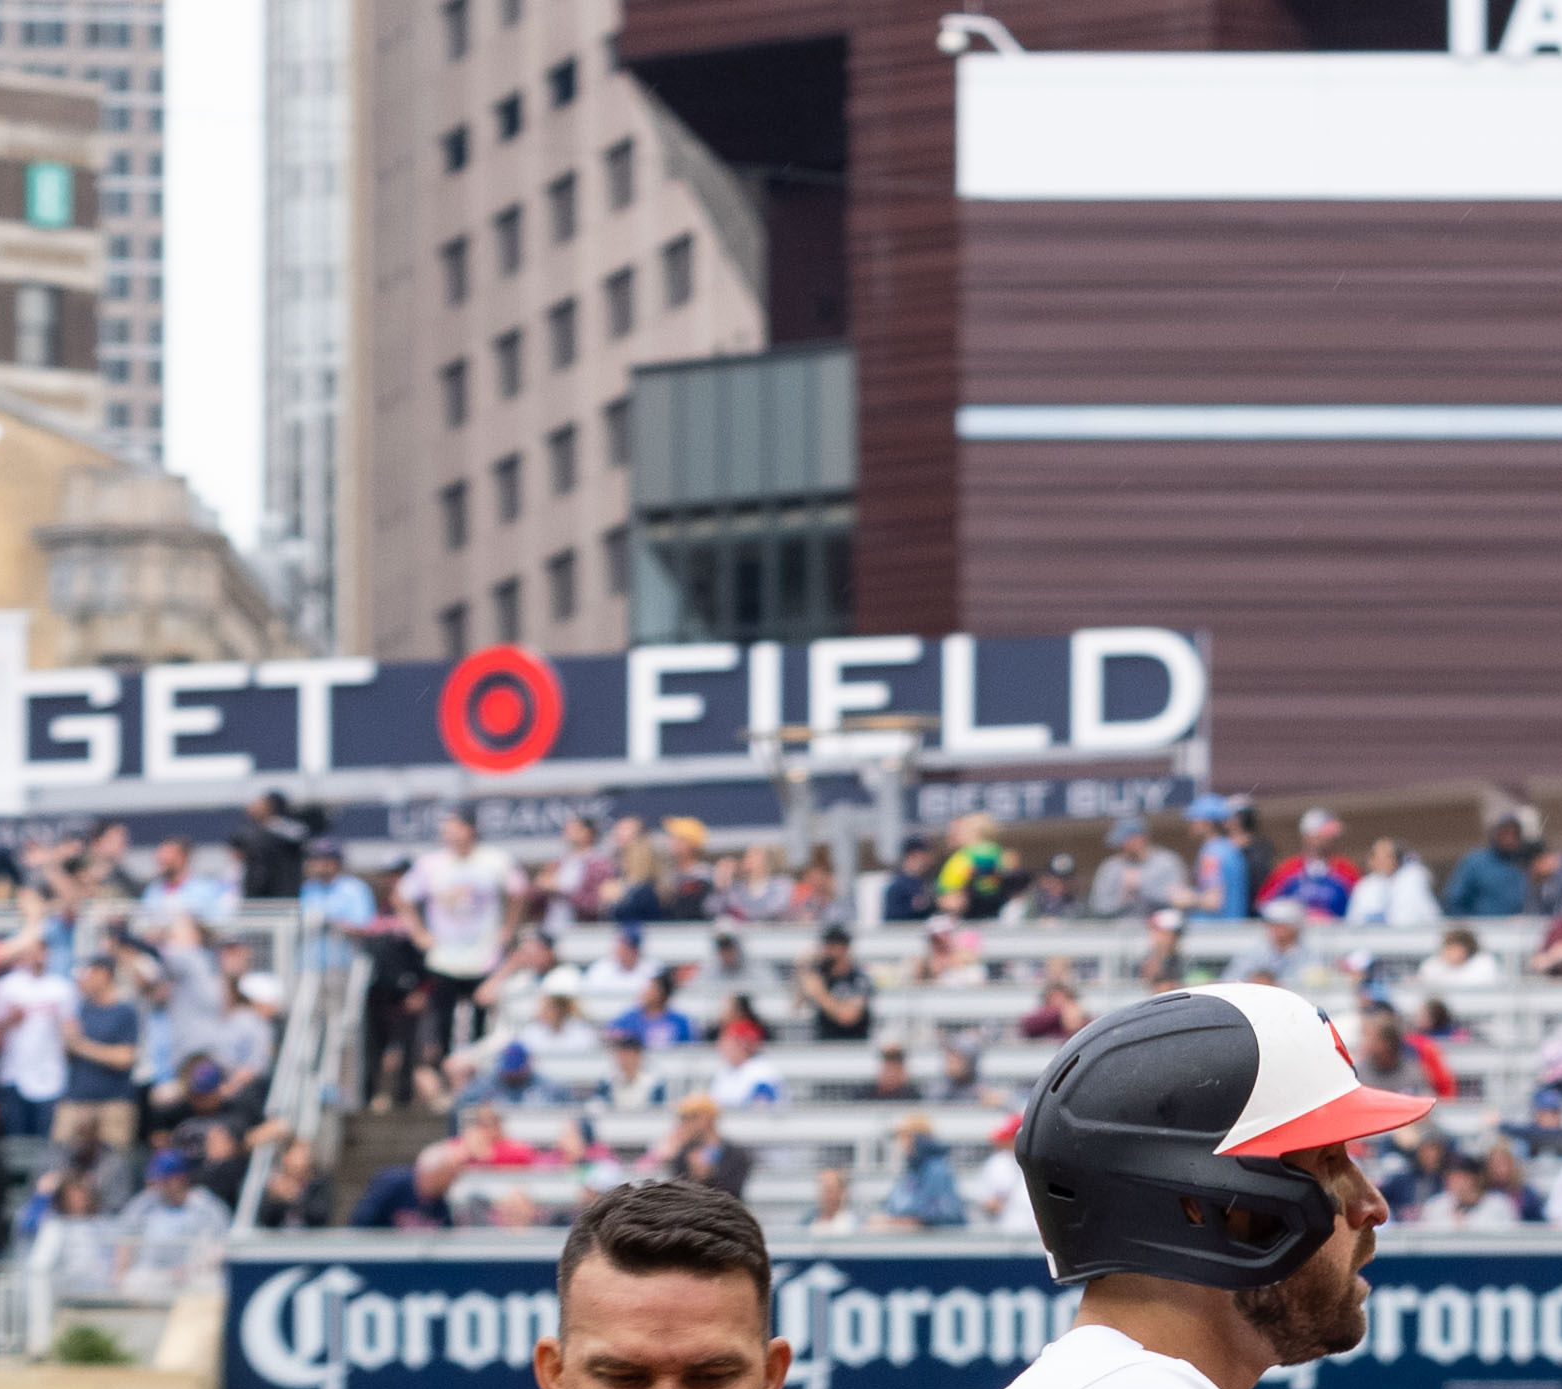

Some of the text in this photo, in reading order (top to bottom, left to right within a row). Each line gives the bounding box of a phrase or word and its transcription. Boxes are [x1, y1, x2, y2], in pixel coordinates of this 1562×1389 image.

[625, 625, 1208, 764] FIELD
[917, 778, 1176, 821] BEST BUY
